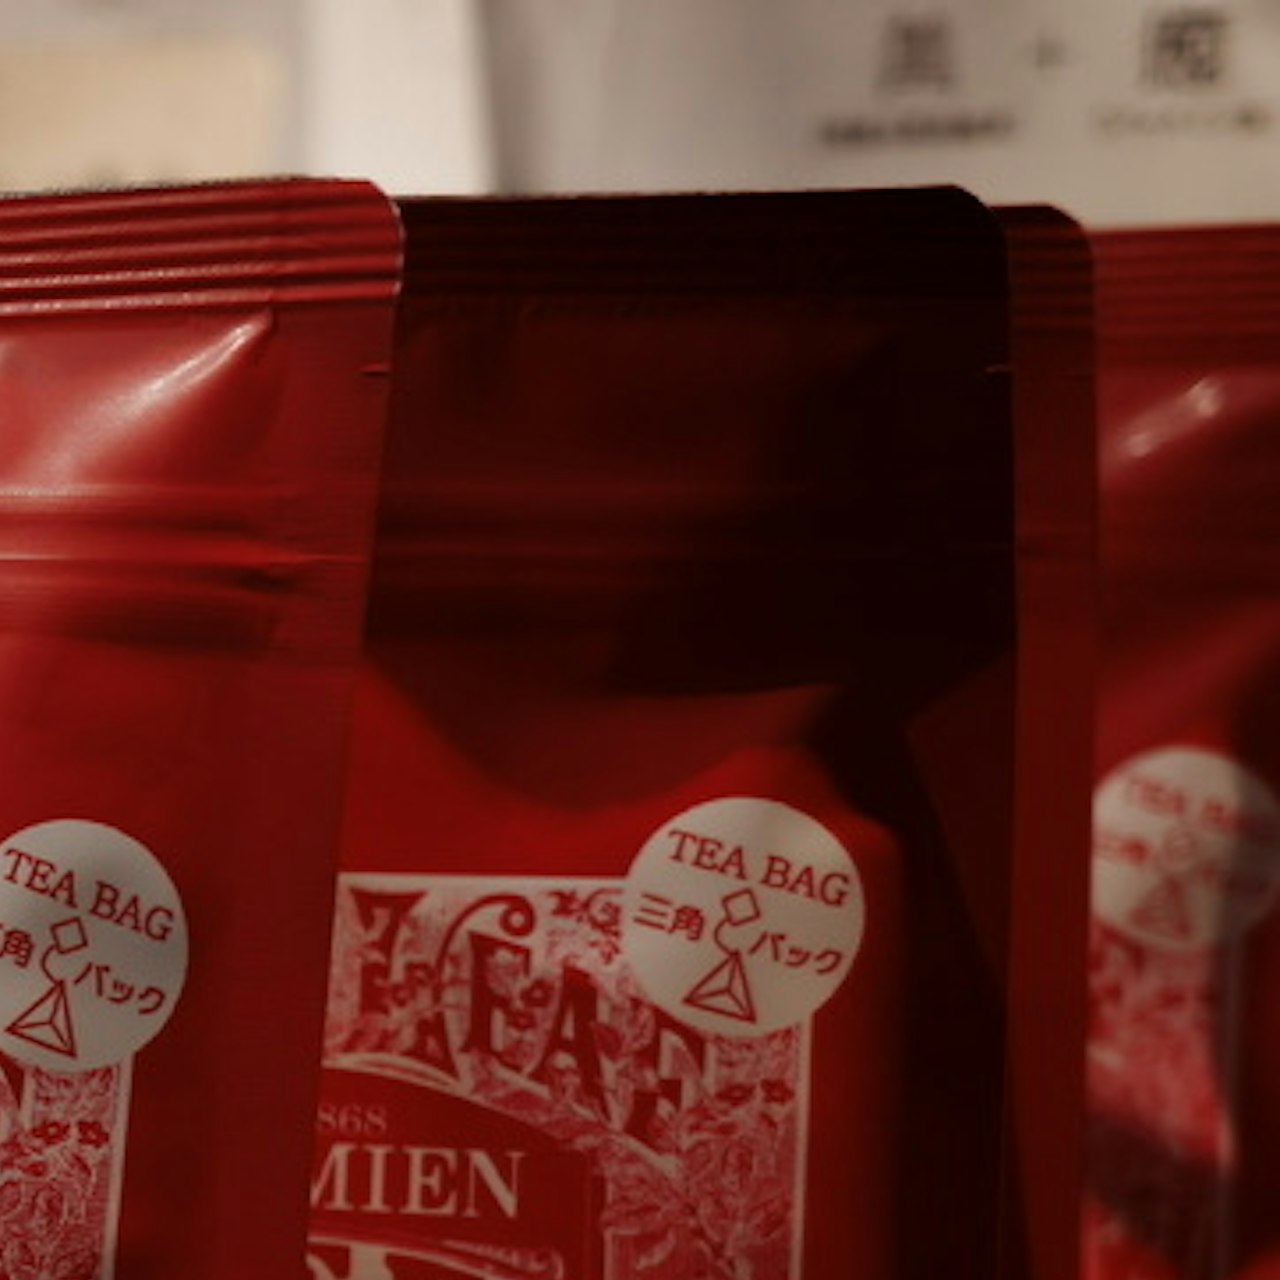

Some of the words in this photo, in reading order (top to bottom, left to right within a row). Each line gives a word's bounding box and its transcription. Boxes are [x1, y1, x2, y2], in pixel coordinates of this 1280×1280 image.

[4, 848, 80, 909] TEA
[89, 880, 176, 943] BAG
[668, 829, 748, 880] TEA
[760, 855, 850, 907] BAG
[633, 893, 704, 942] 三角
